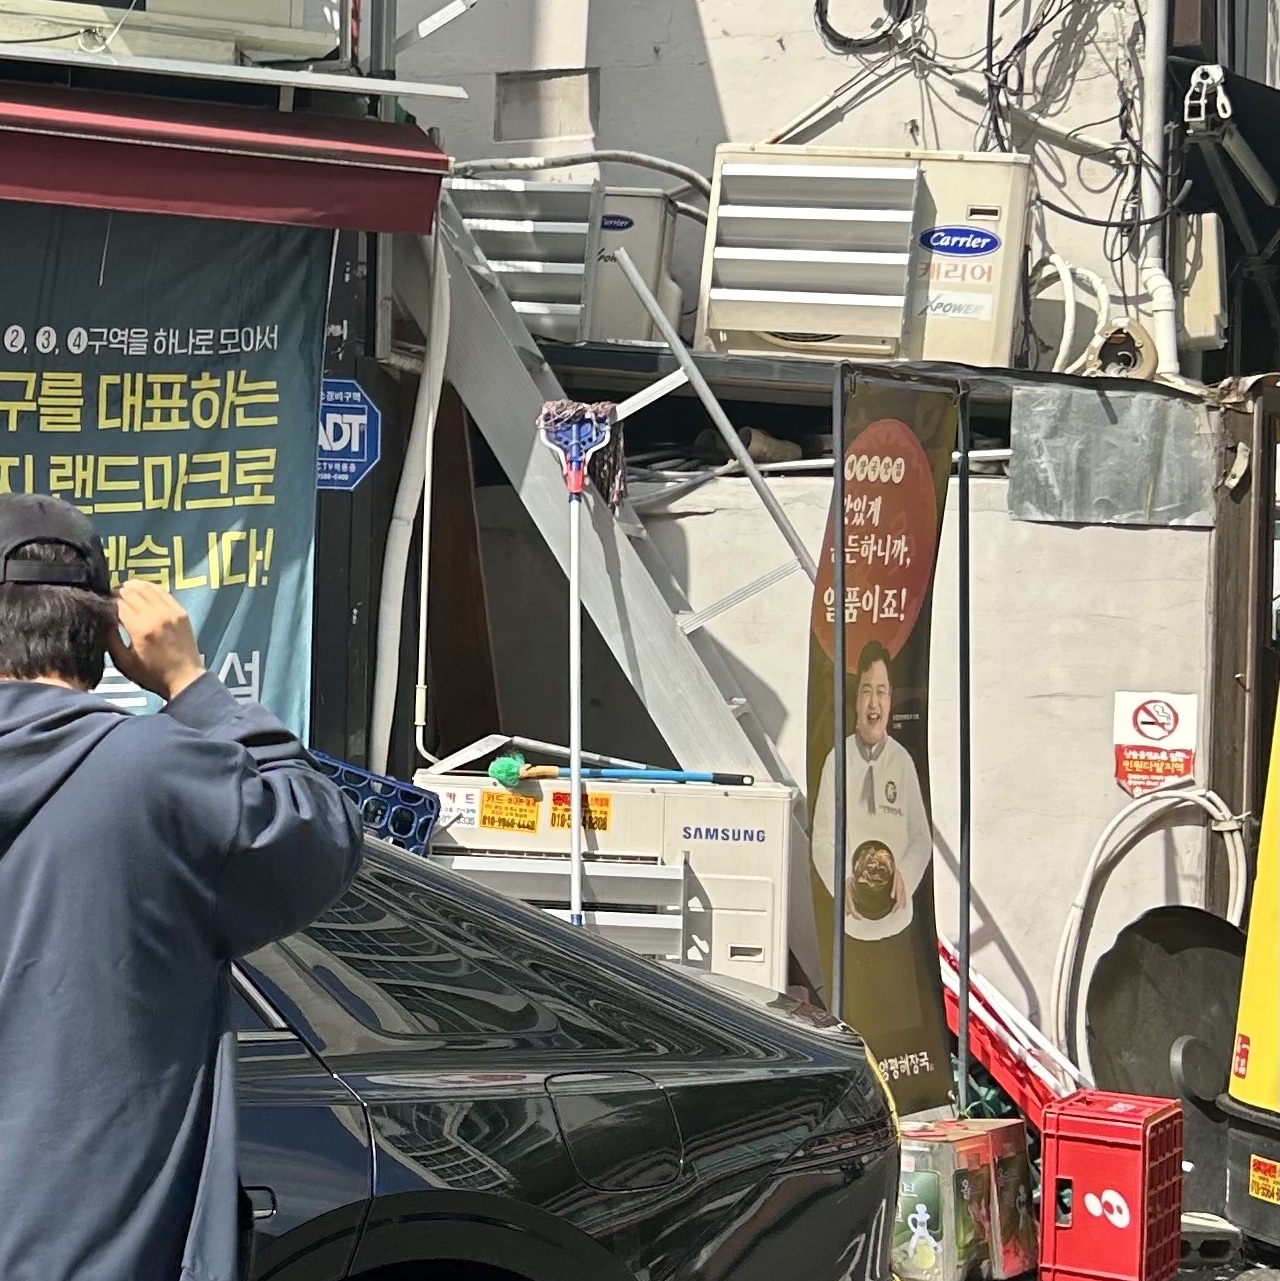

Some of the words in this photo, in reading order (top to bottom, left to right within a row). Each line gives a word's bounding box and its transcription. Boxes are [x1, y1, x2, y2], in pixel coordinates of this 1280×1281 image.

[929, 232, 991, 249] Carrier
[153, 328, 215, 355] 하나로
[218, 324, 280, 354] 모아서
[97, 369, 280, 433] 대표하는
[48, 447, 278, 515] 랜드마크로
[830, 533, 911, 569] 든하니까,
[682, 826, 766, 842] SAMSUNG
